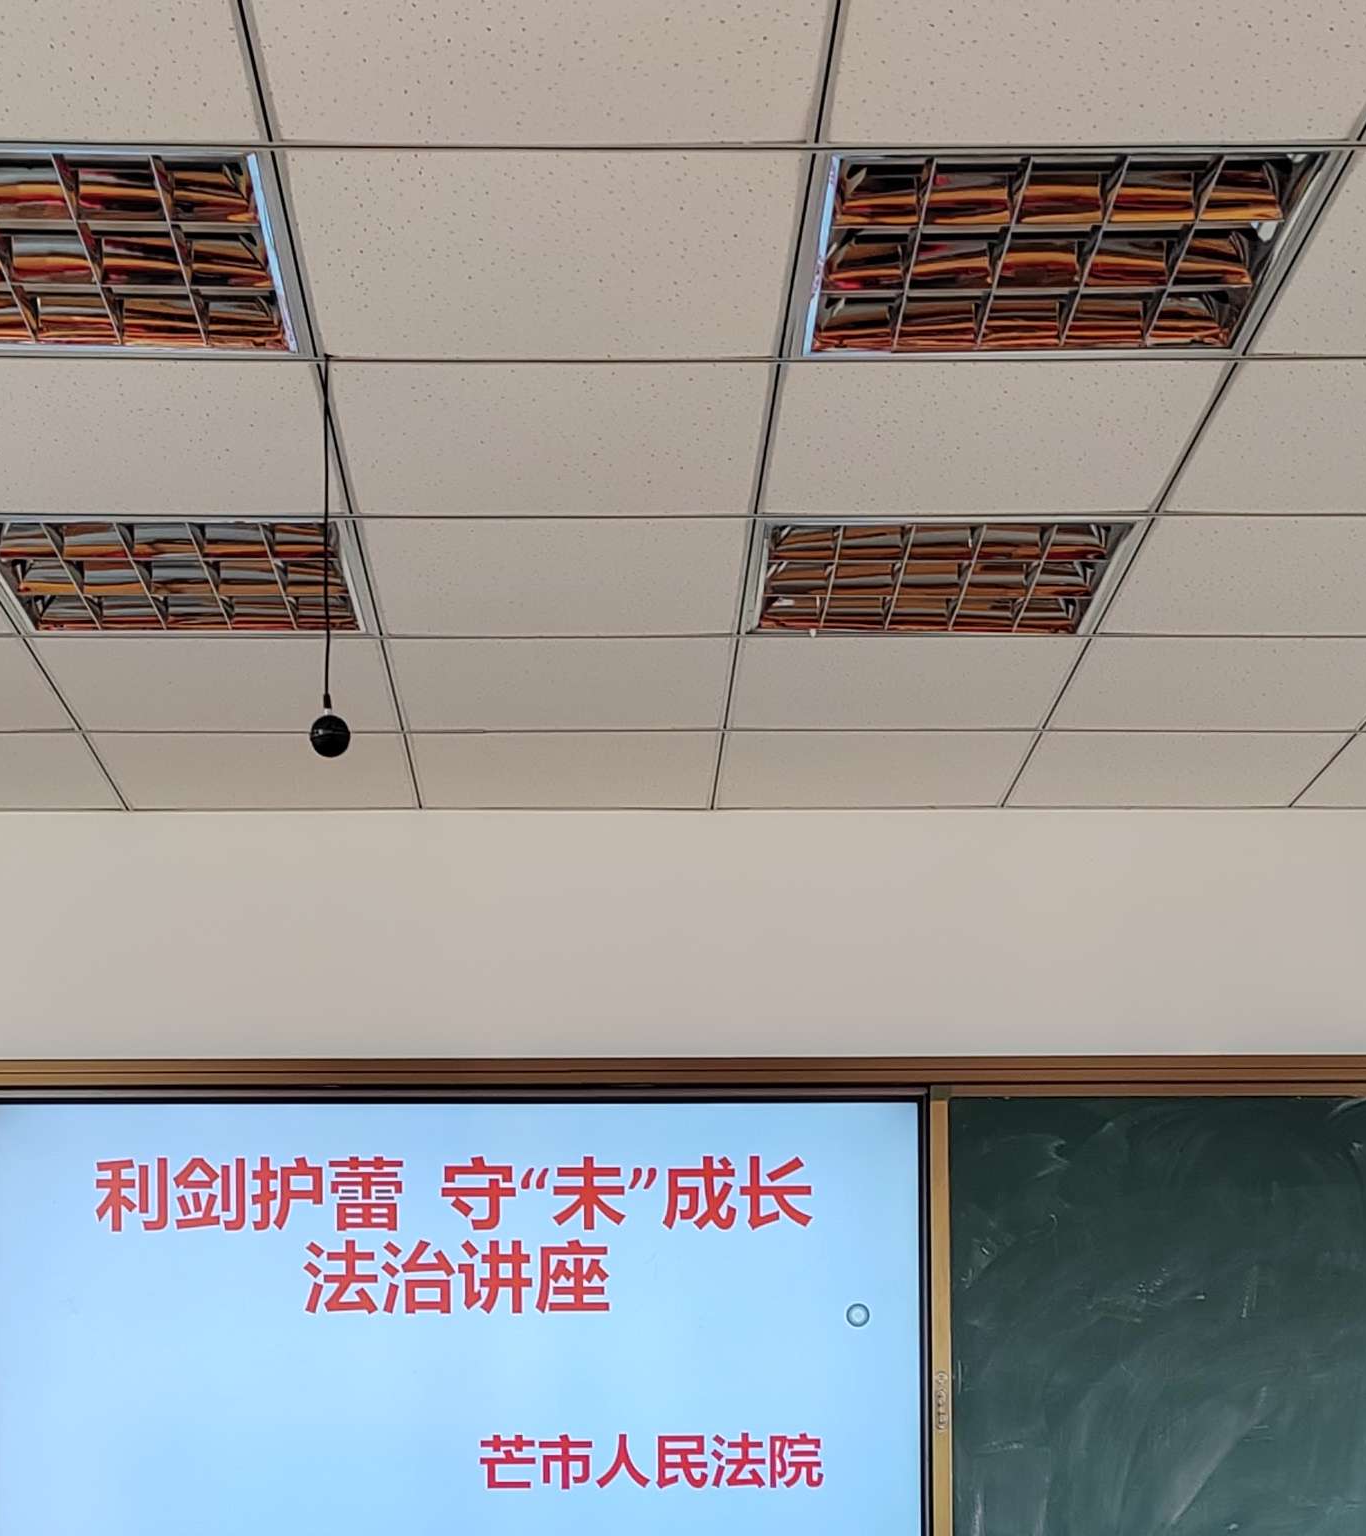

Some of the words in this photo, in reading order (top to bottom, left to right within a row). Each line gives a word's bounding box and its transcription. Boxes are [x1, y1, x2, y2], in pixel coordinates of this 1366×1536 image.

[96, 1156, 403, 1232] 利剑护蕾
[440, 1155, 812, 1231] 守“未”成长
[304, 1239, 610, 1314] 法治讲座
[480, 1432, 824, 1489] 芒市人民法院
